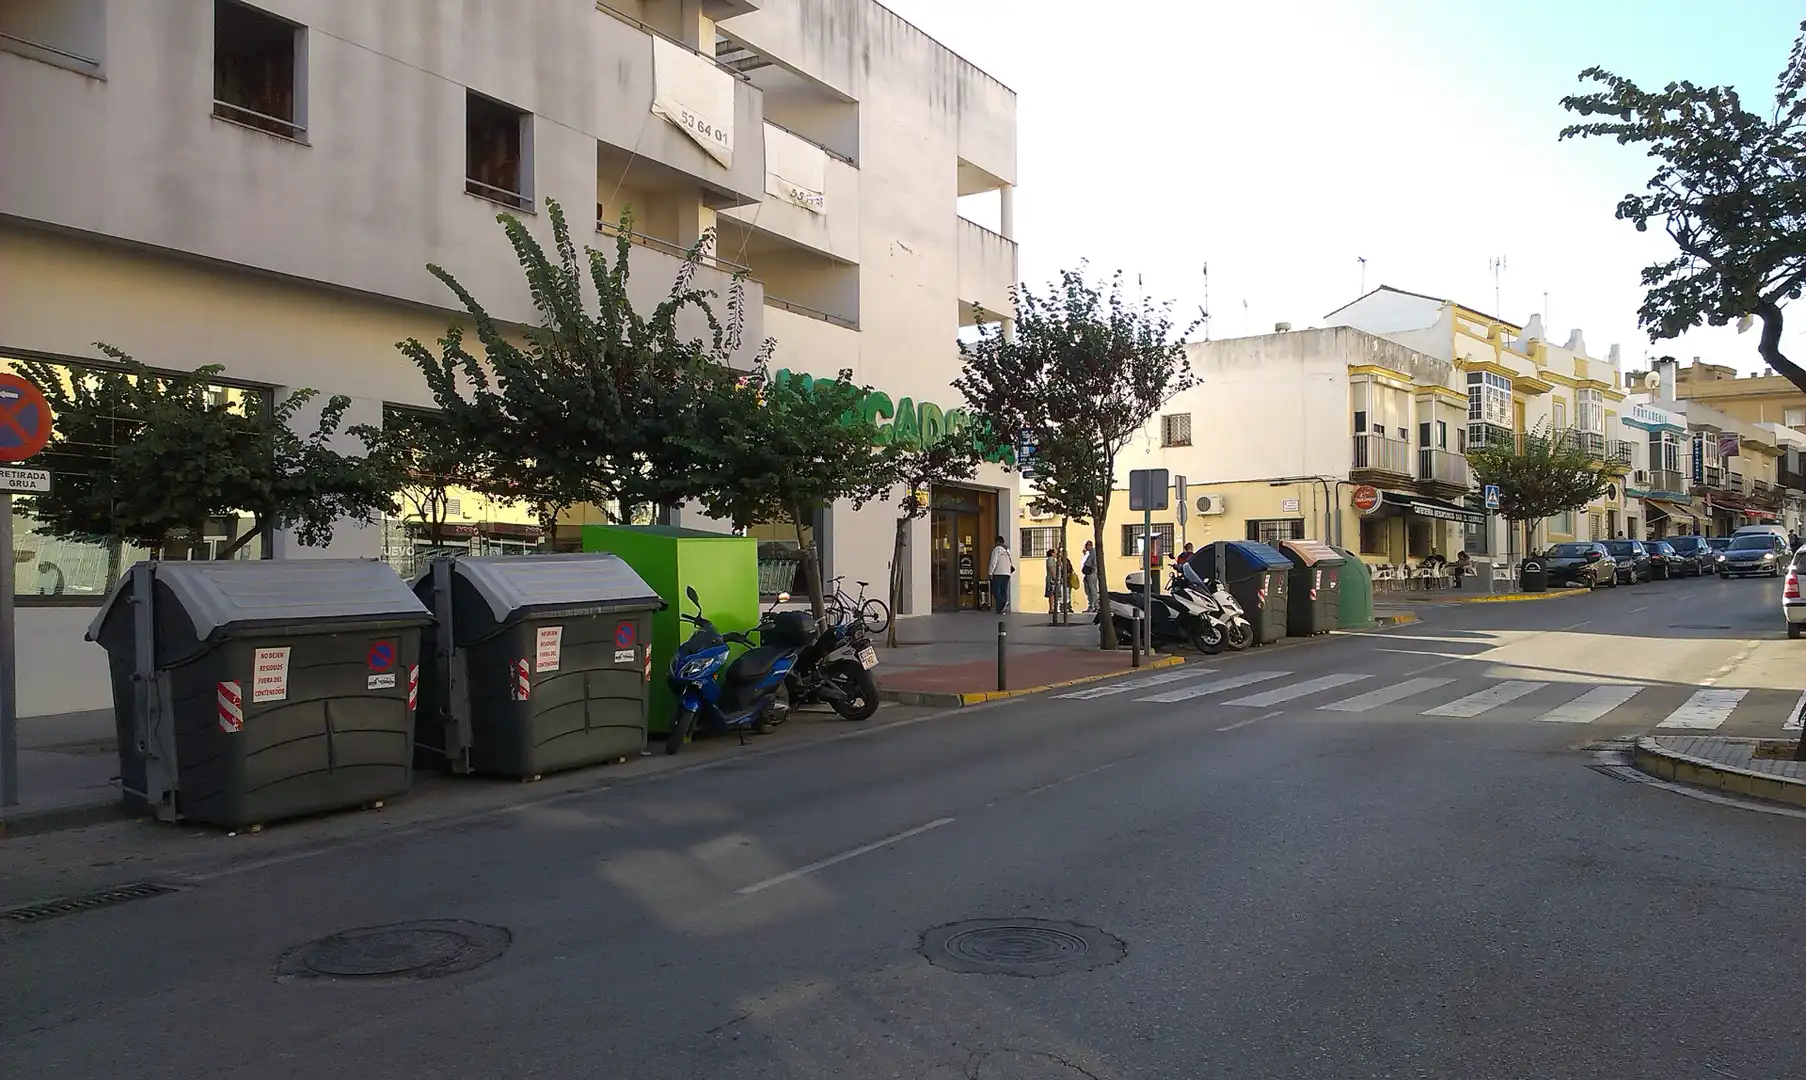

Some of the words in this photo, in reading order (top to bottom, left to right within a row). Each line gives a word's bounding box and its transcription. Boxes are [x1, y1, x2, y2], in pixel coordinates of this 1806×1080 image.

[682, 111, 695, 128] 53
[697, 120, 711, 137] 64
[715, 129, 728, 146] 01
[0, 470, 46, 480] RETIRADA
[9, 479, 37, 488] GRUA
[381, 546, 415, 556] UEVO
[538, 660, 558, 668] CONTENEDOR
[255, 688, 285, 697] CONTENEDOR
